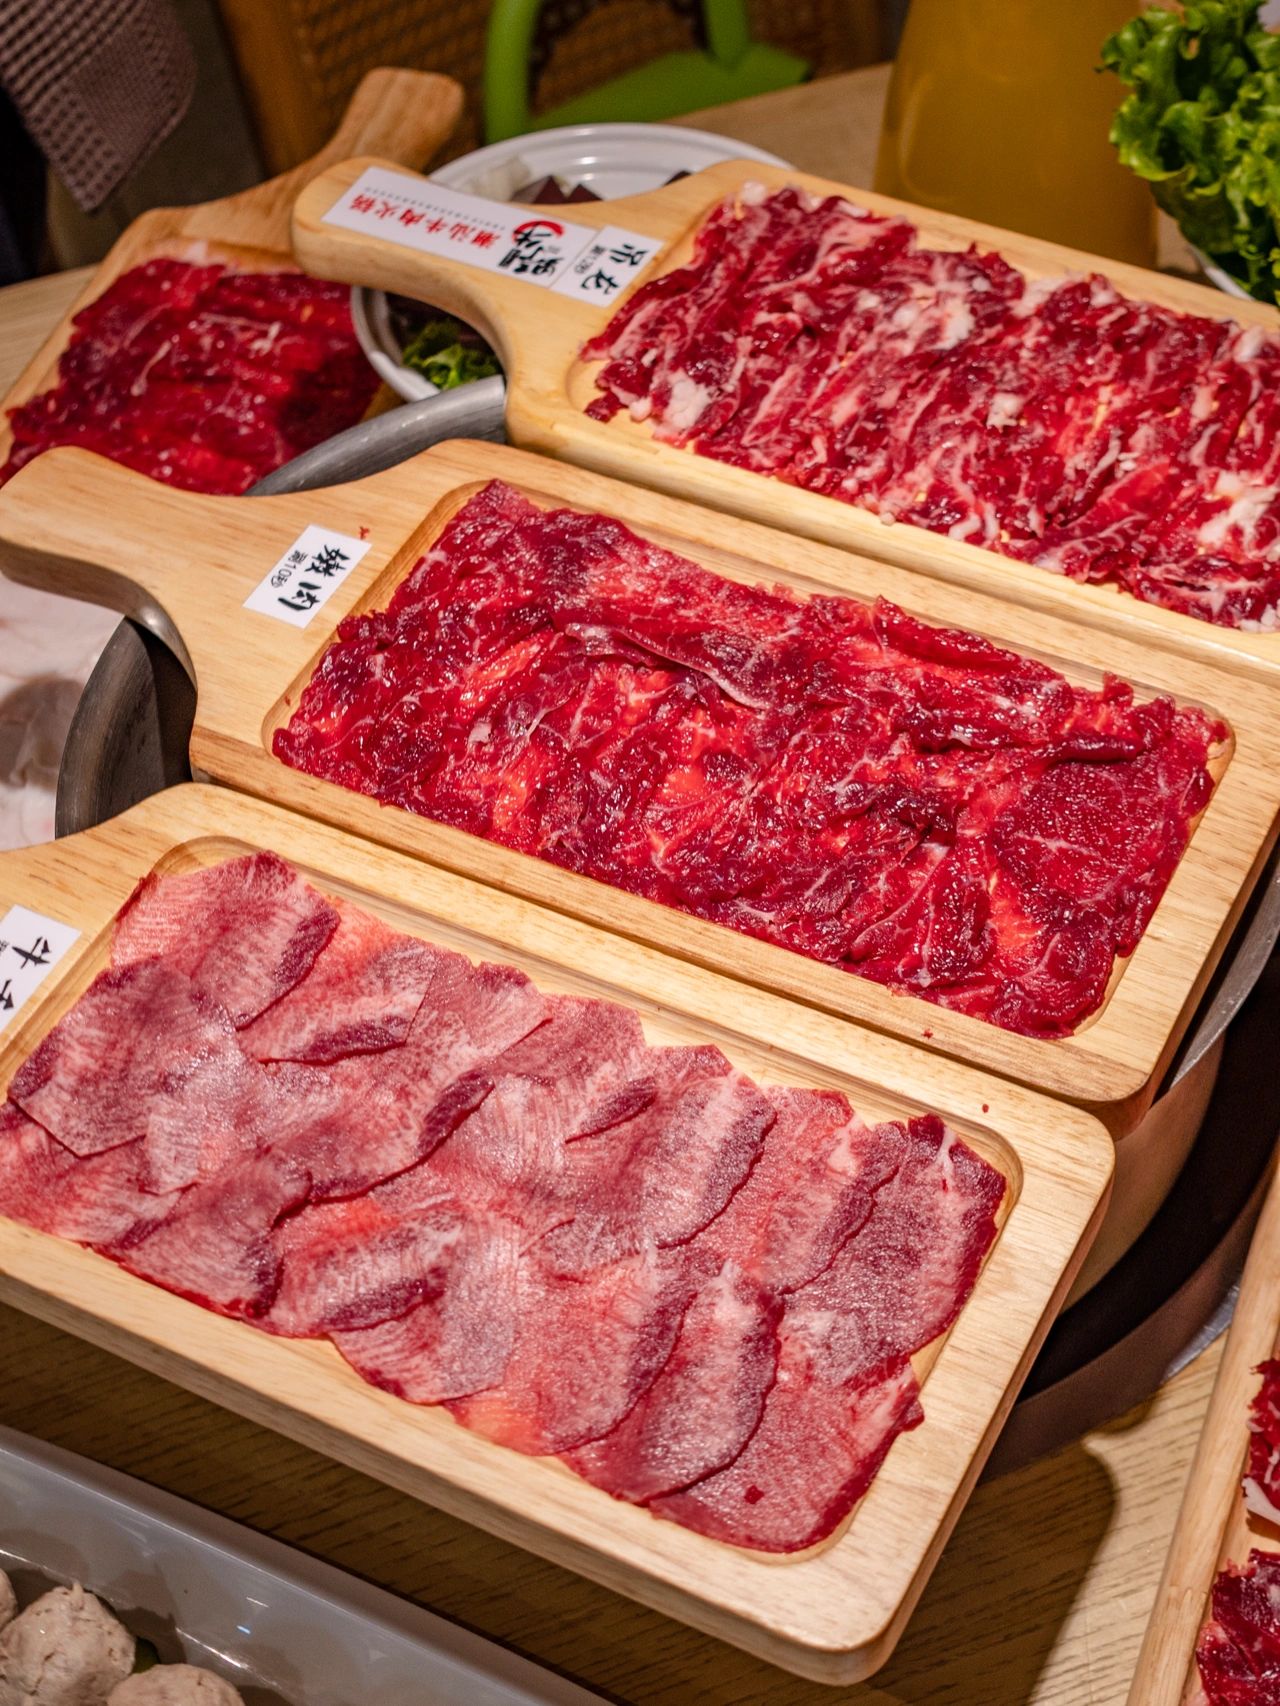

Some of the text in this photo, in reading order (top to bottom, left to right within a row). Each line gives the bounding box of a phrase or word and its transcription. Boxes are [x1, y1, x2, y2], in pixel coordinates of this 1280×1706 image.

[350, 194, 500, 249] 潮汕牛肉火锅
[580, 244, 648, 295] 吊龙
[271, 550, 308, 588] 涮10秒
[278, 544, 350, 611] 嫩肉
